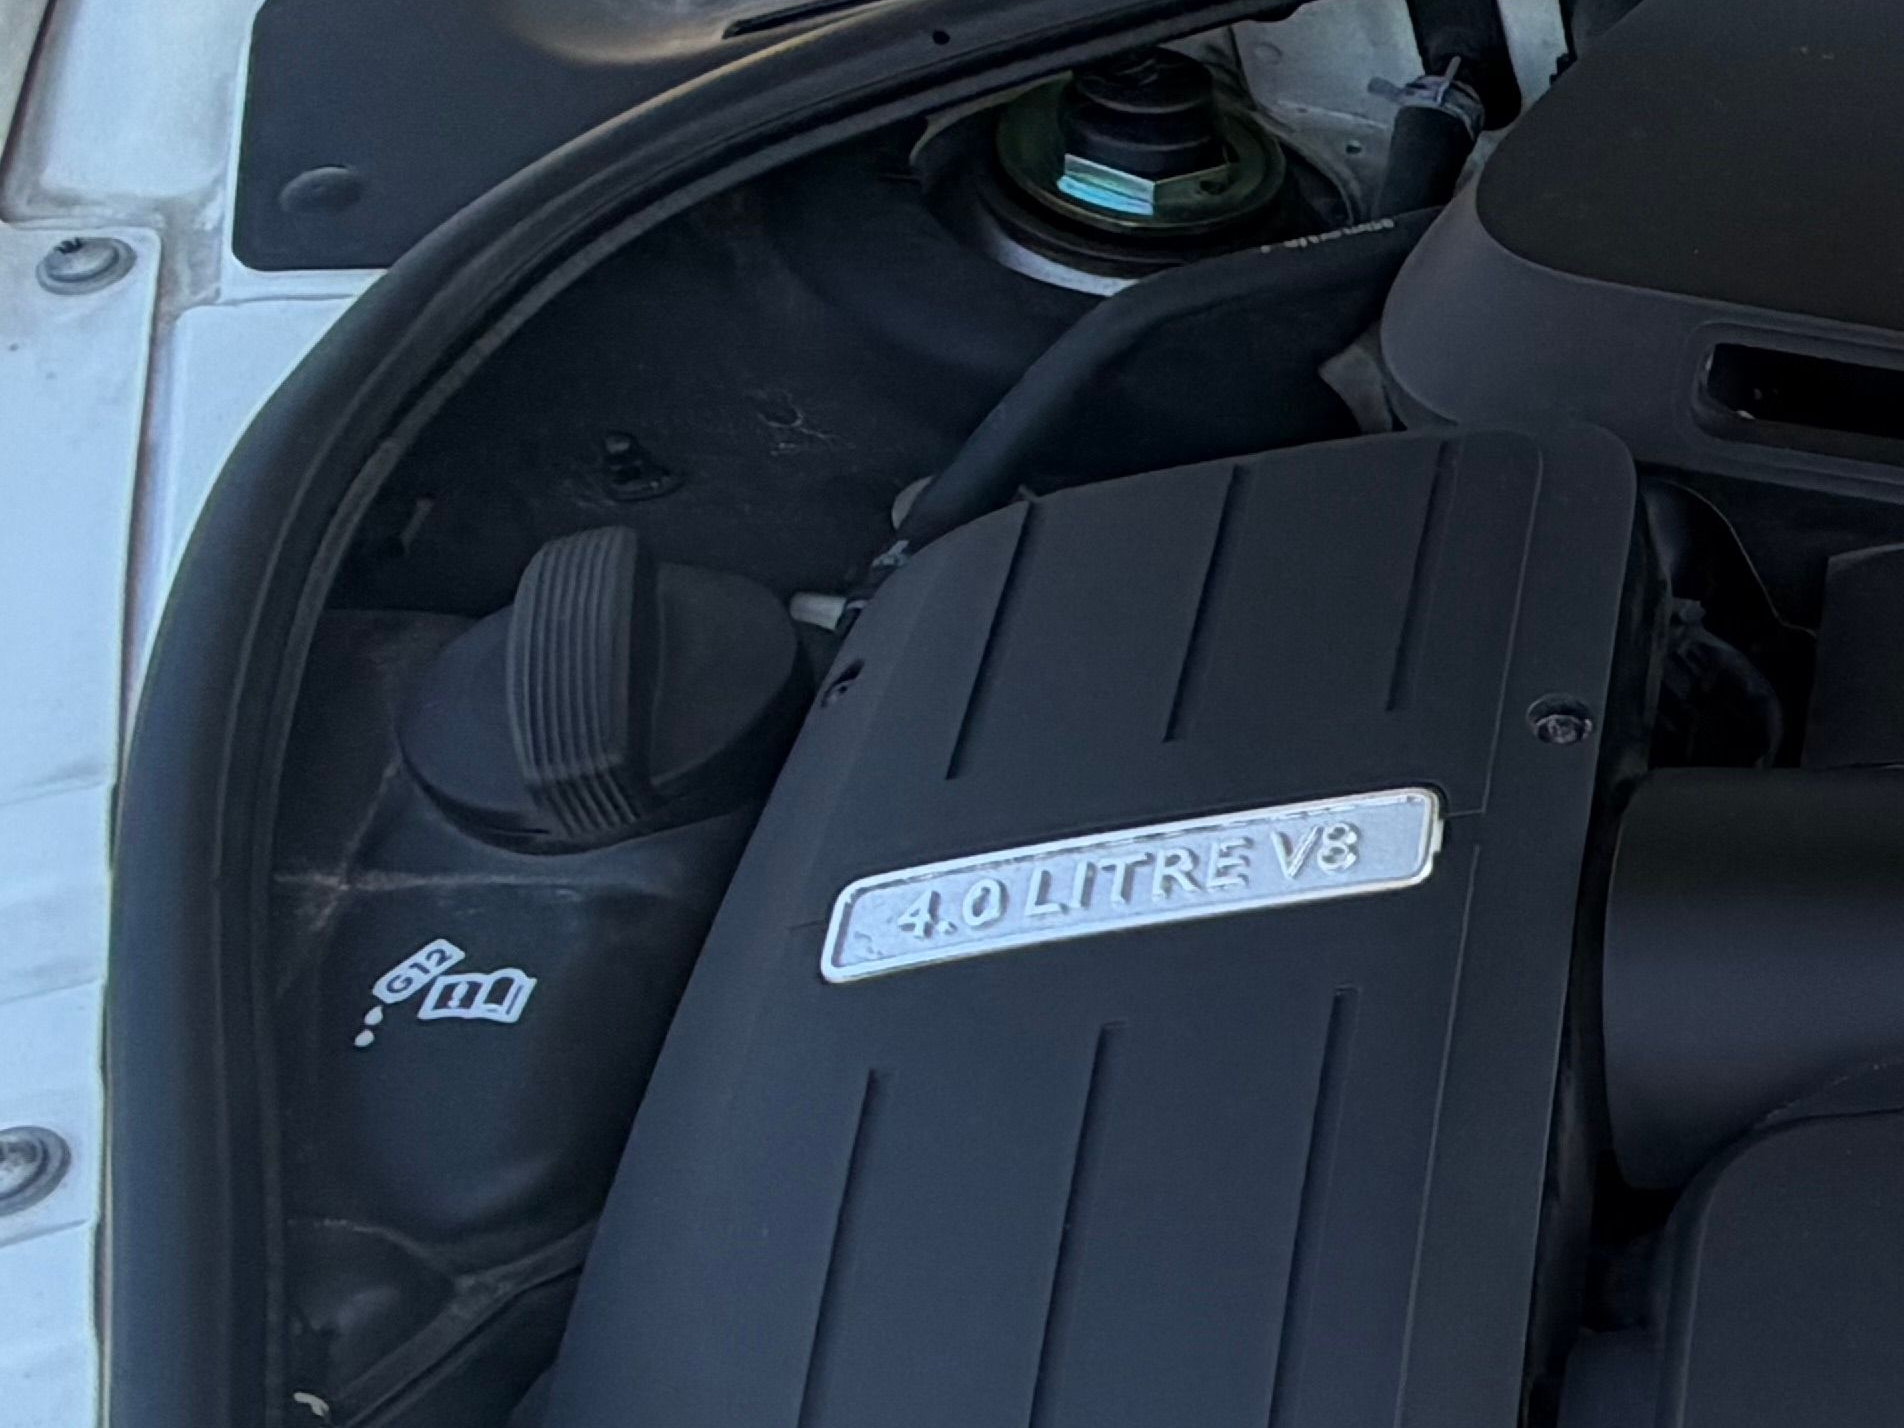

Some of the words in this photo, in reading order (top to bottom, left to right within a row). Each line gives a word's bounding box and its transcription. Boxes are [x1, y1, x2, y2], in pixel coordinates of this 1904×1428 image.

[894, 875, 1011, 941] 4.0
[1024, 832, 1256, 918] LITRE
[1270, 820, 1363, 882] V8
[385, 947, 453, 994] G12
